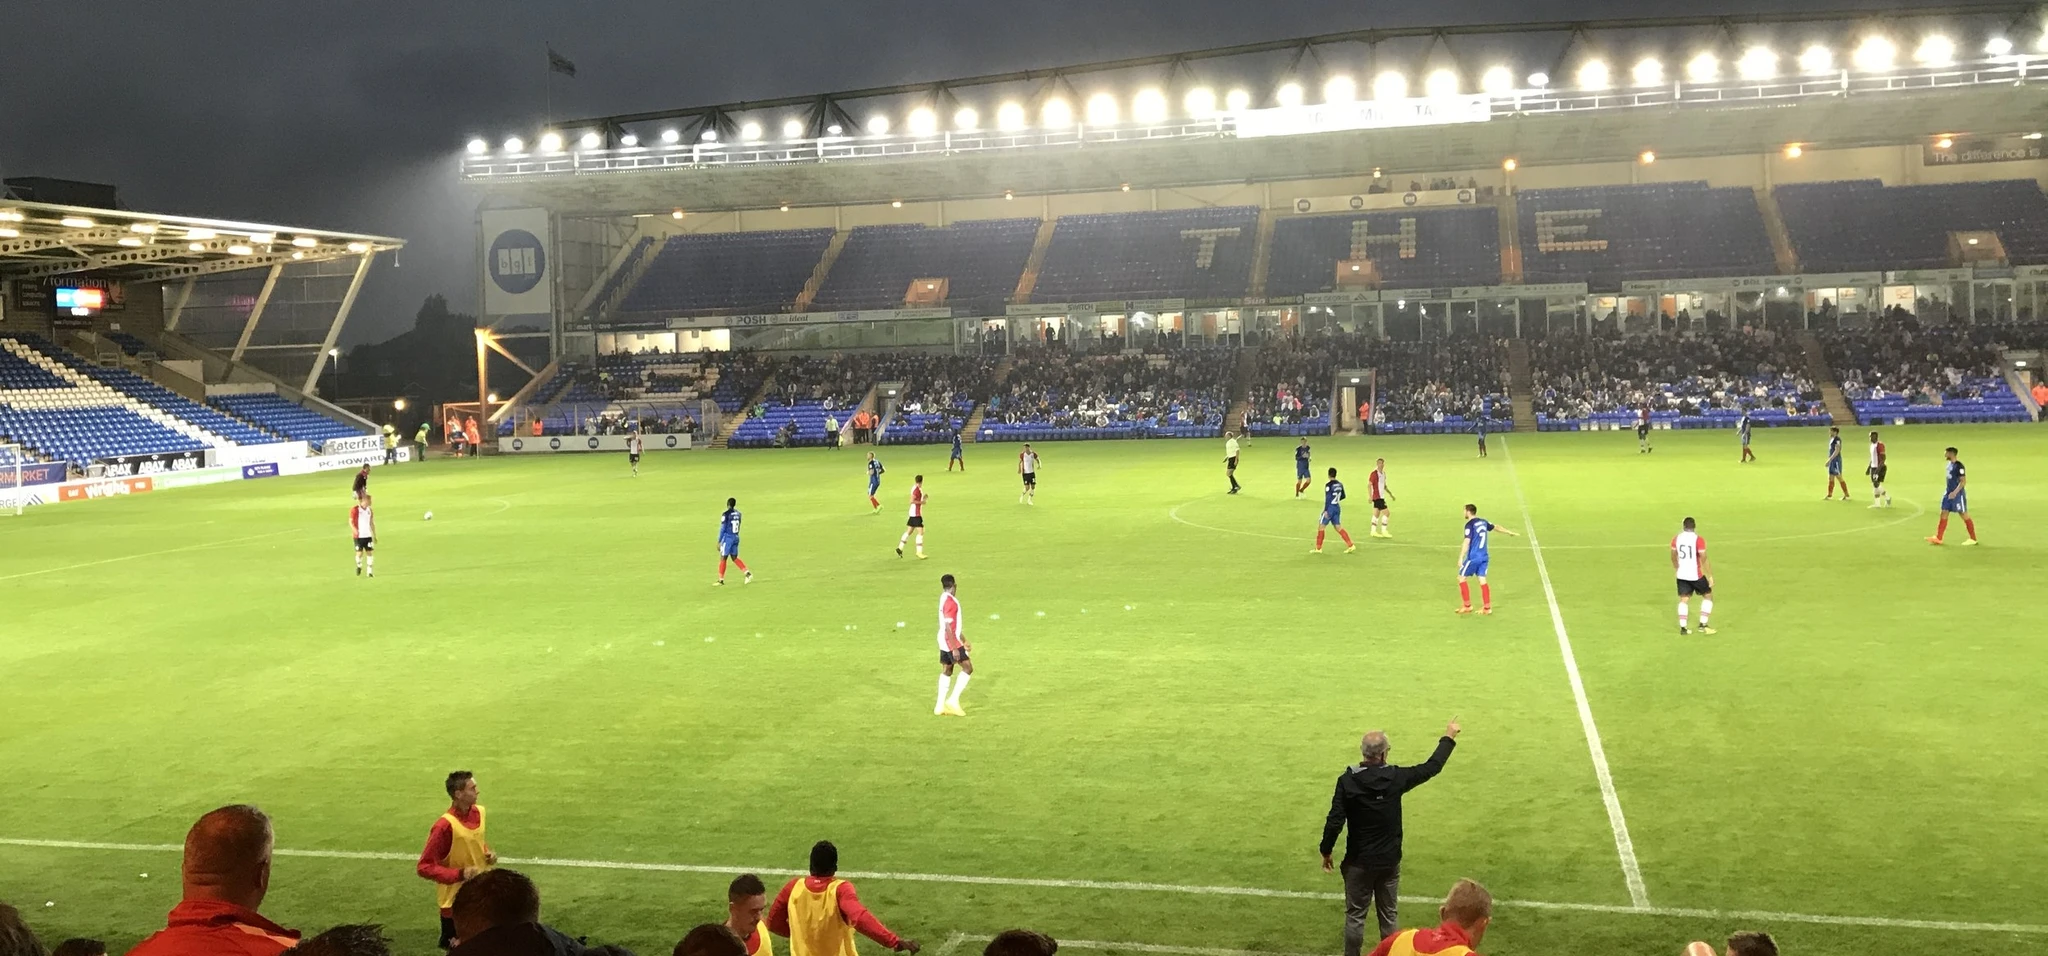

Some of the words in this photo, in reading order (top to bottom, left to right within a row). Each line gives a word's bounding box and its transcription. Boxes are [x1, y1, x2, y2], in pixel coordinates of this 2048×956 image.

[1935, 152, 1957, 163] The
[1961, 149, 2025, 162] difference
[736, 315, 767, 325] POSH
[334, 437, 378, 451] aterFix
[1478, 531, 1487, 549] 7
[1678, 543, 1694, 560] 51
